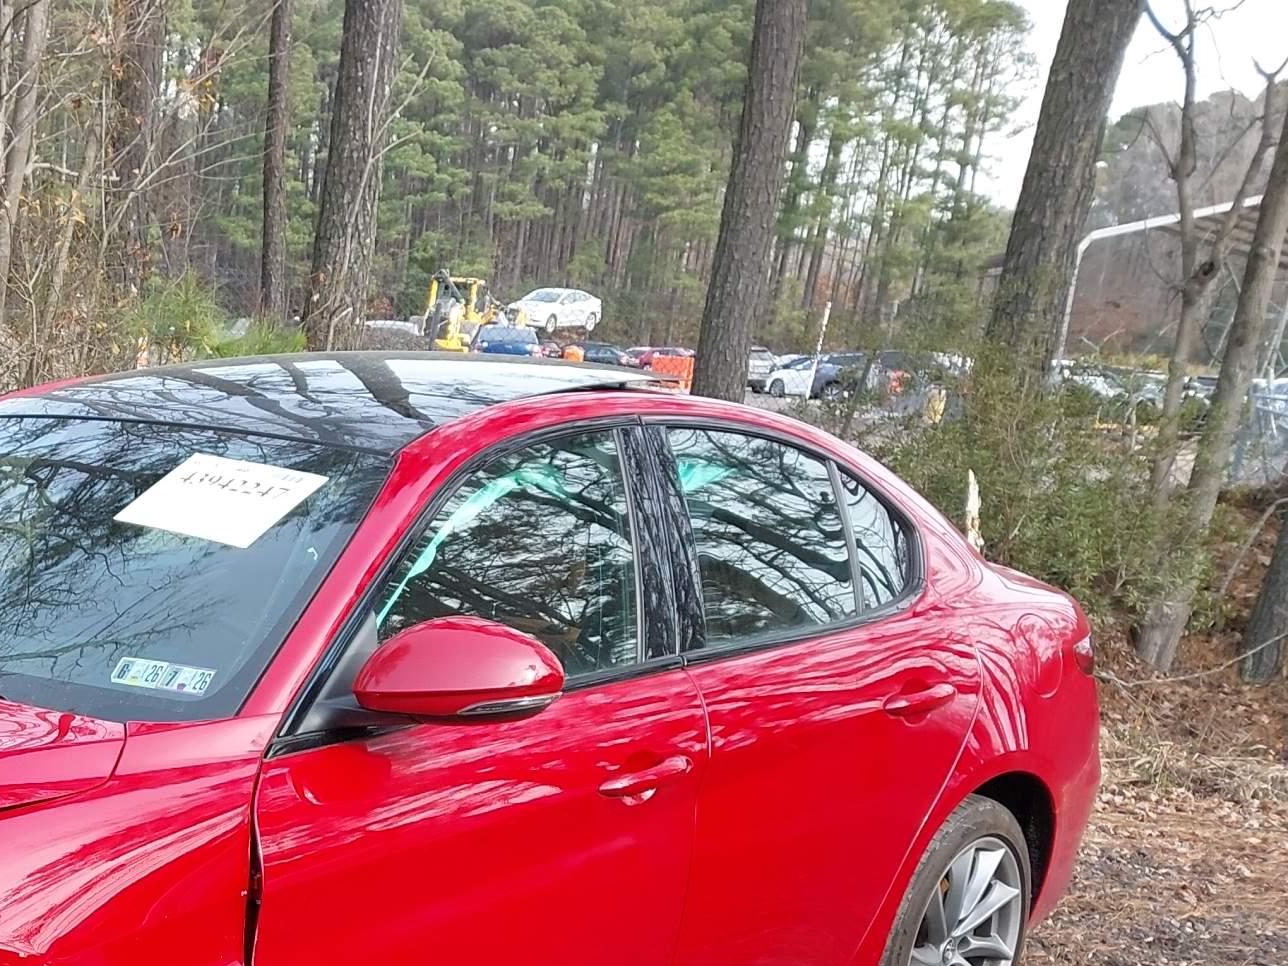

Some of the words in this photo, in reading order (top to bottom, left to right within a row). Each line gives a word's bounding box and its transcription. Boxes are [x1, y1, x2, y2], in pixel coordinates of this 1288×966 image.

[116, 663, 130, 679] 6
[144, 664, 164, 682] 26
[191, 671, 212, 691] 26
